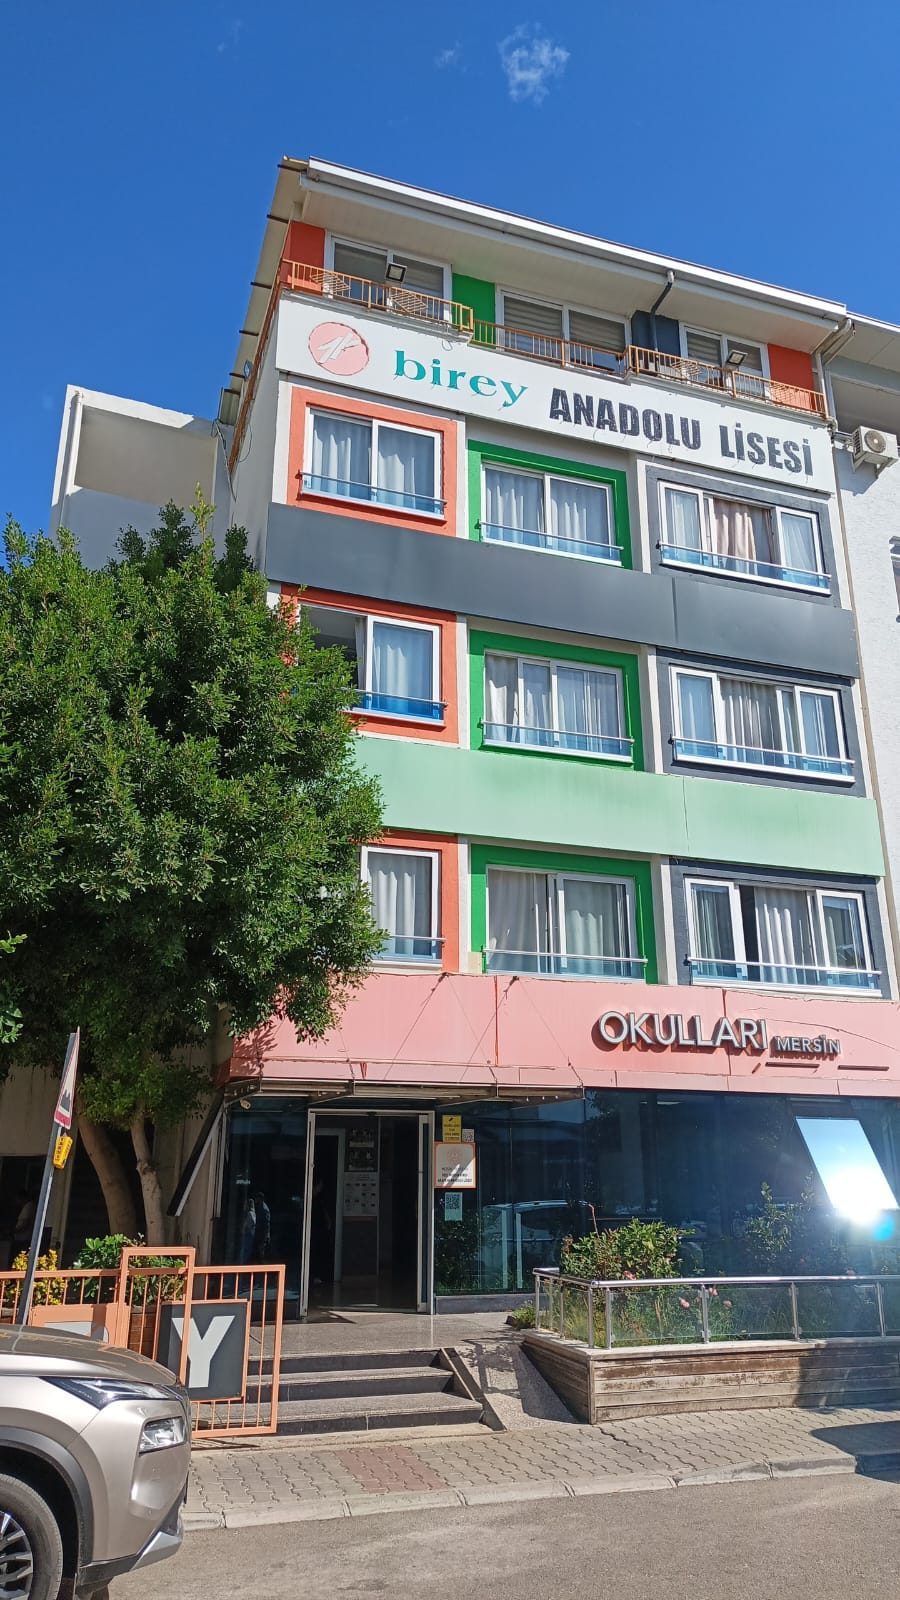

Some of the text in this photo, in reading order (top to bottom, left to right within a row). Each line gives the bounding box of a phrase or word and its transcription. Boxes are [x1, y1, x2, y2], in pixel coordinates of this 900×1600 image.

[393, 350, 814, 477] birey ANADOLU LİSESİ
[598, 1010, 840, 1054] OKULLARI MERSİN
[171, 1315, 235, 1388] Y
